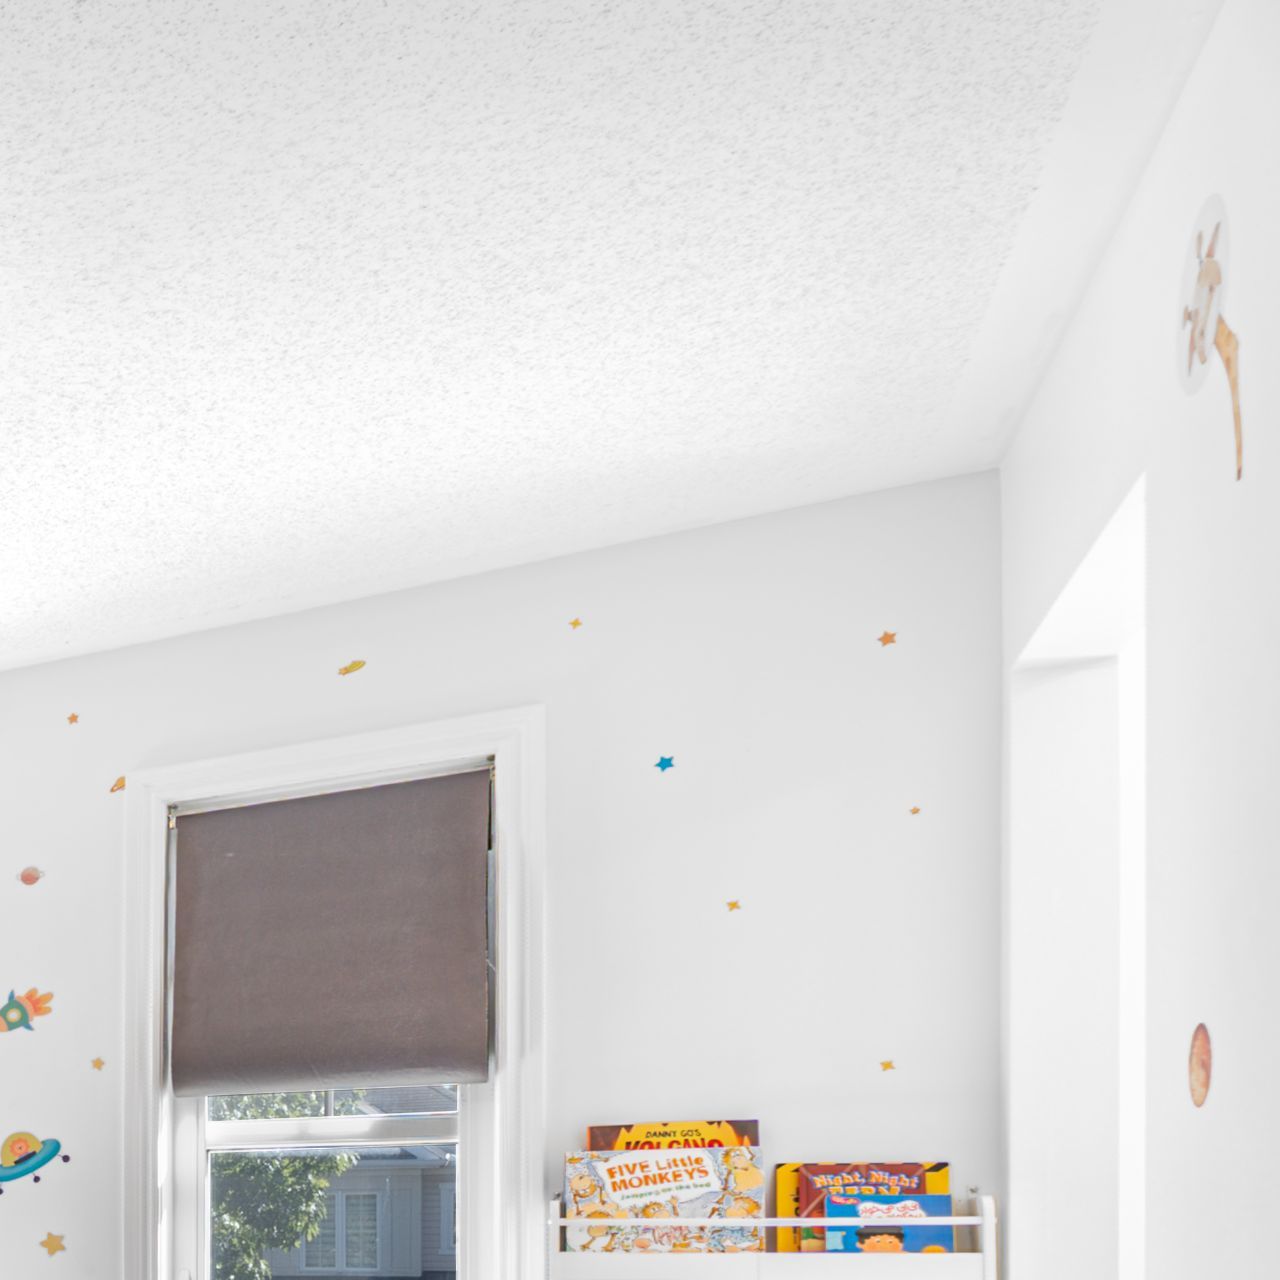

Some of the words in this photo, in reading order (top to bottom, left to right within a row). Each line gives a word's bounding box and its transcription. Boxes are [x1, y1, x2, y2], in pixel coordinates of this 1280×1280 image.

[645, 1130, 677, 1138] DANNY
[606, 1160, 650, 1179] FIVE
[610, 1166, 709, 1192] MONKEYS
[869, 1170, 919, 1189] Night
